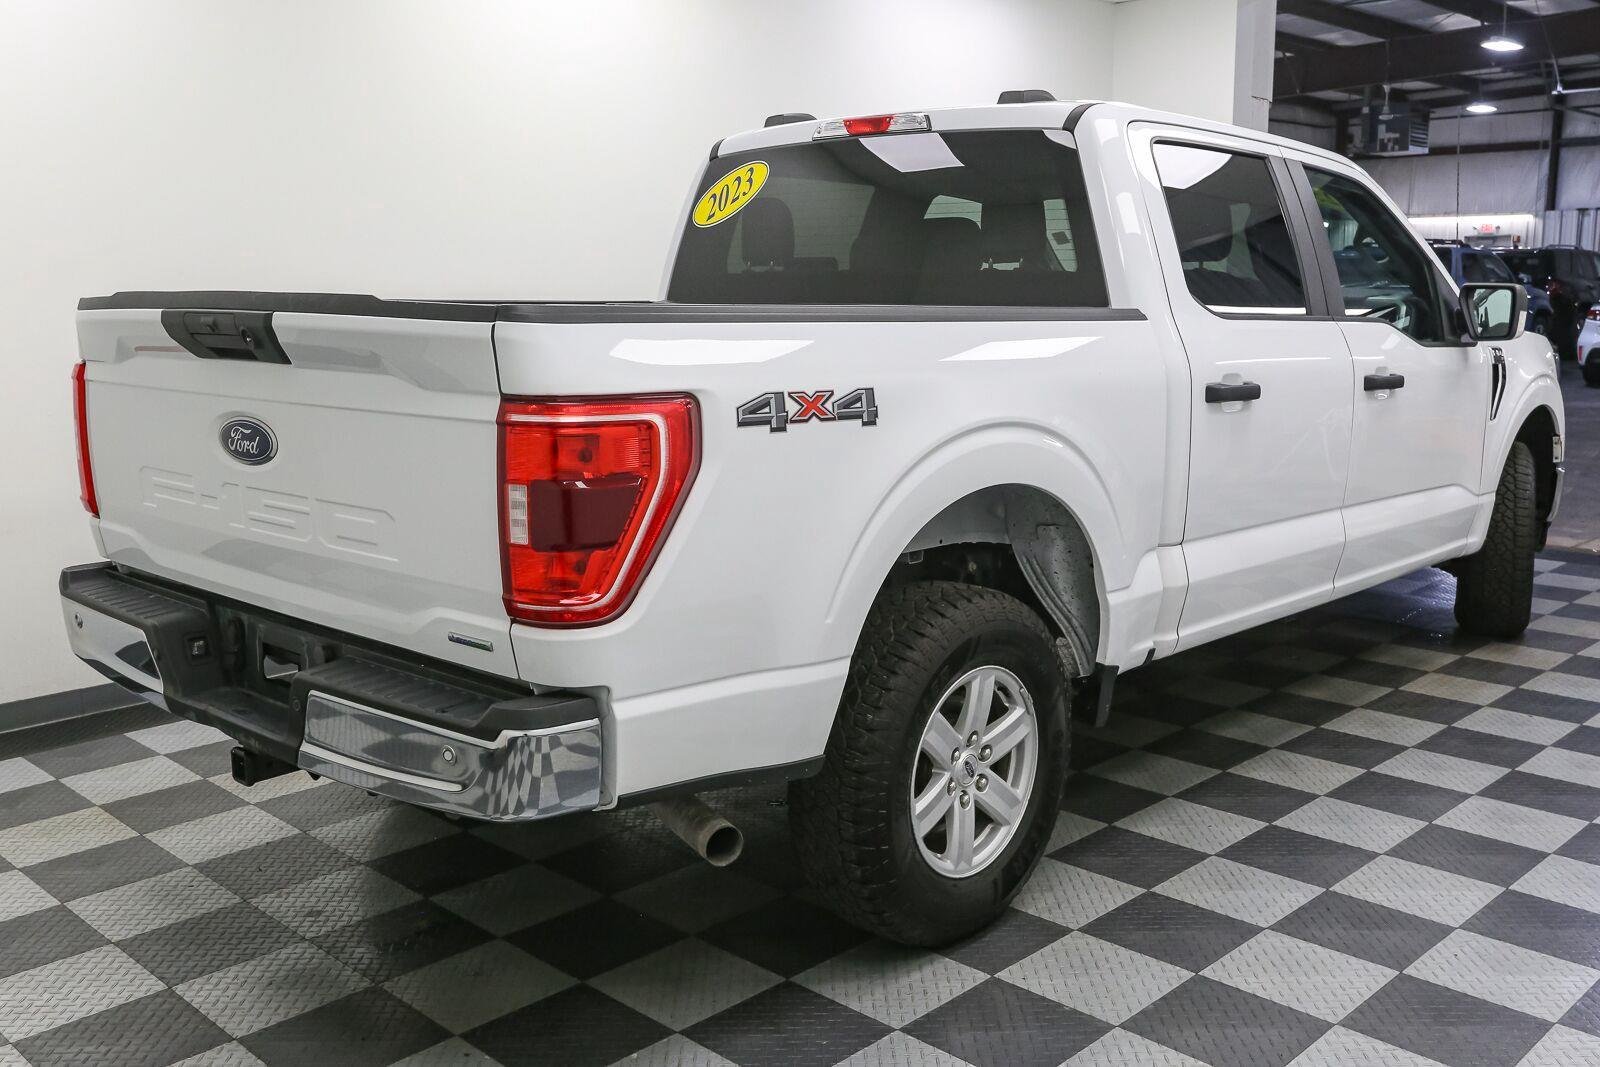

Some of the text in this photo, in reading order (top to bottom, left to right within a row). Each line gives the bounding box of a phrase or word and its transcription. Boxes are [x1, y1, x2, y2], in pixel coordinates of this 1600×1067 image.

[706, 166, 755, 222] 2023
[228, 426, 260, 454] Ford
[139, 465, 399, 562] F-150
